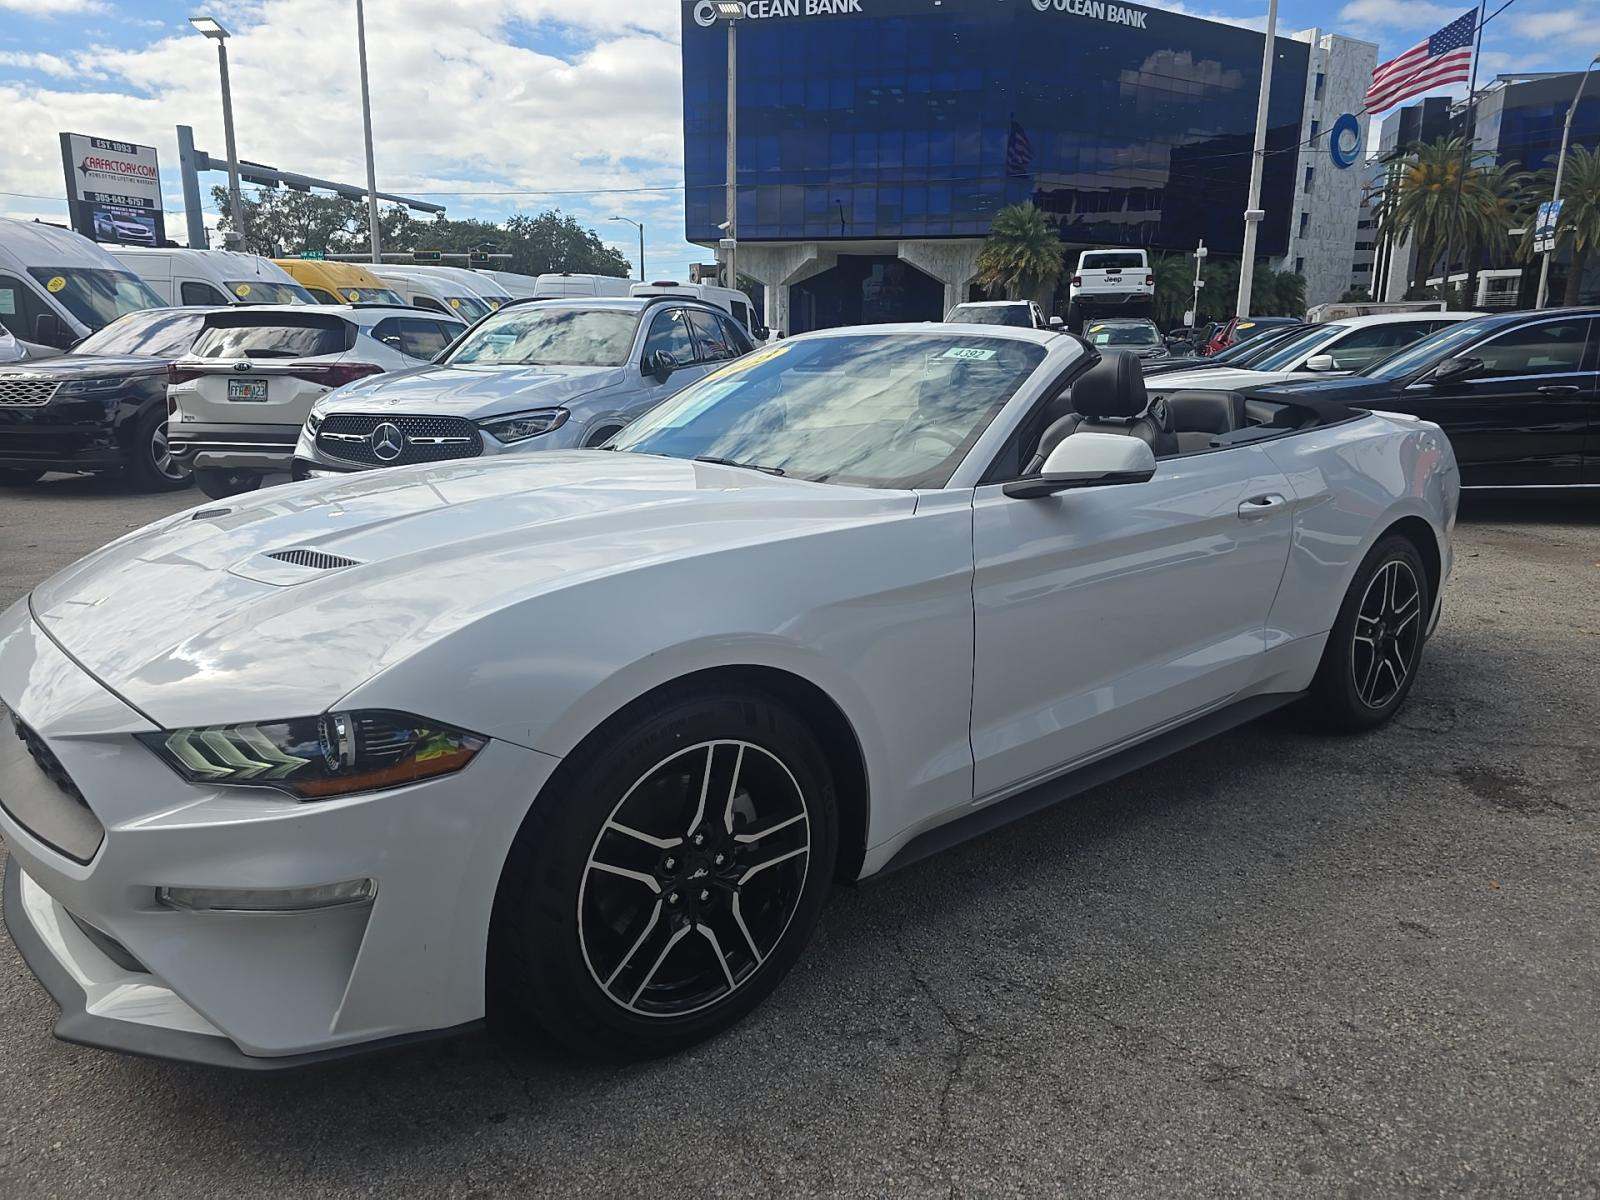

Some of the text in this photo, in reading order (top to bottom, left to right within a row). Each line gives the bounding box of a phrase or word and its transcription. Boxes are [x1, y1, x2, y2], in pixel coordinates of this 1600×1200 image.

[806, 0, 863, 16] BANK
[1053, 0, 1148, 29] OCEAN BANK
[96, 139, 132, 153] EST. 1993
[84, 156, 156, 177] CARFACTORY.COM
[94, 193, 144, 206] 305-642-6757
[1103, 276, 1122, 284] Jeep
[953, 349, 986, 359] 4392
